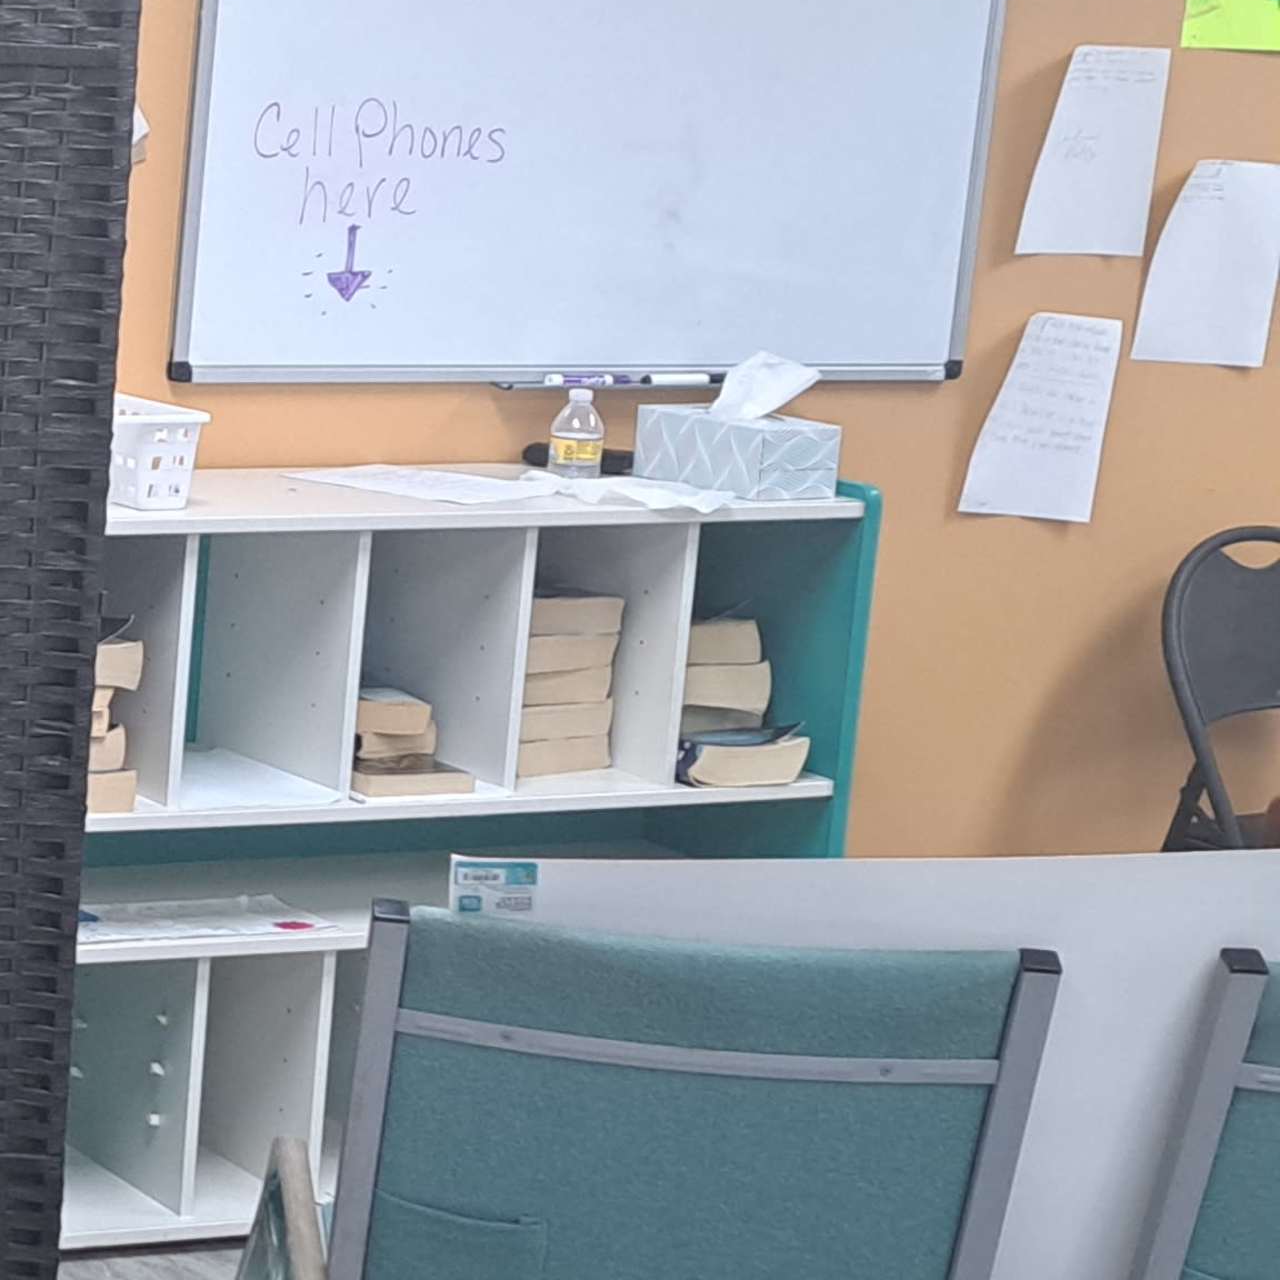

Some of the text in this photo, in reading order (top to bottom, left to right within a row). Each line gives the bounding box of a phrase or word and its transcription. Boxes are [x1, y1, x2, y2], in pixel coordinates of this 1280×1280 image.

[254, 97, 507, 169] Cell Phones
[298, 165, 417, 226] here
